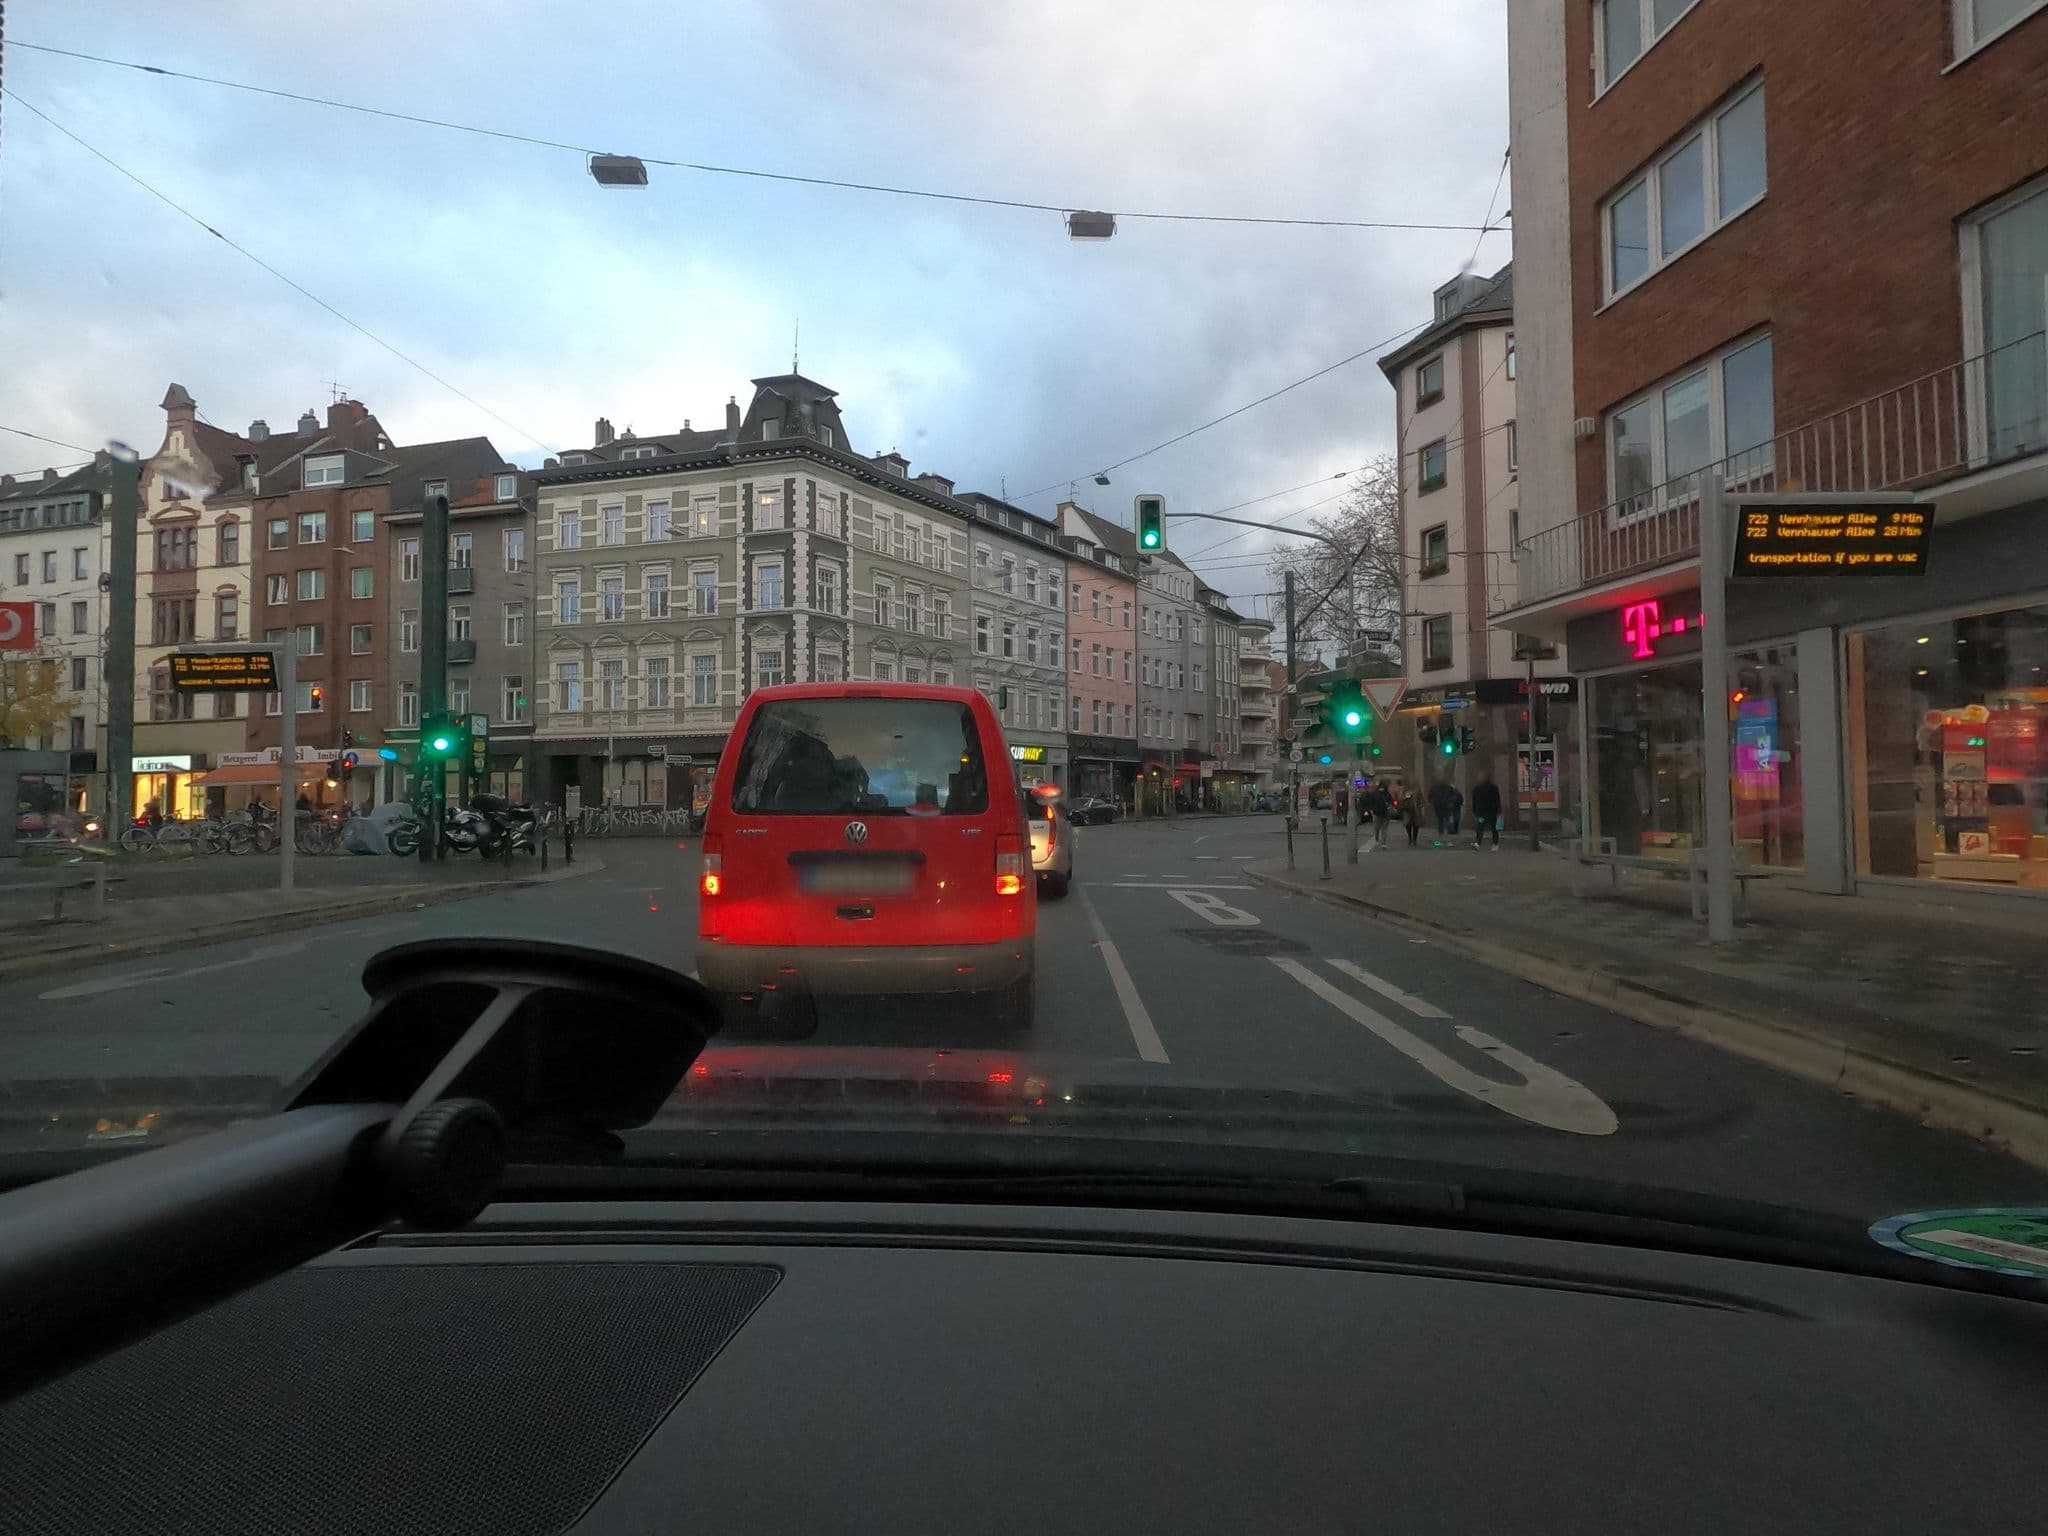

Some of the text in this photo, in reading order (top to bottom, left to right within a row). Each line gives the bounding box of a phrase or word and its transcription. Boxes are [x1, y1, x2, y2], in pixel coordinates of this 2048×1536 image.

[1749, 513, 1924, 524] 722 Vennhauser Allee 9 Min
[1747, 528, 1767, 537] 722
[1778, 527, 1842, 537] Vennhauser
[1847, 527, 1876, 536] Allee
[1900, 527, 1922, 536] Min
[1750, 553, 1918, 565] transportation if you are vac
[1011, 746, 1042, 760] SUBWAY
[223, 754, 258, 764] Metzgerei
